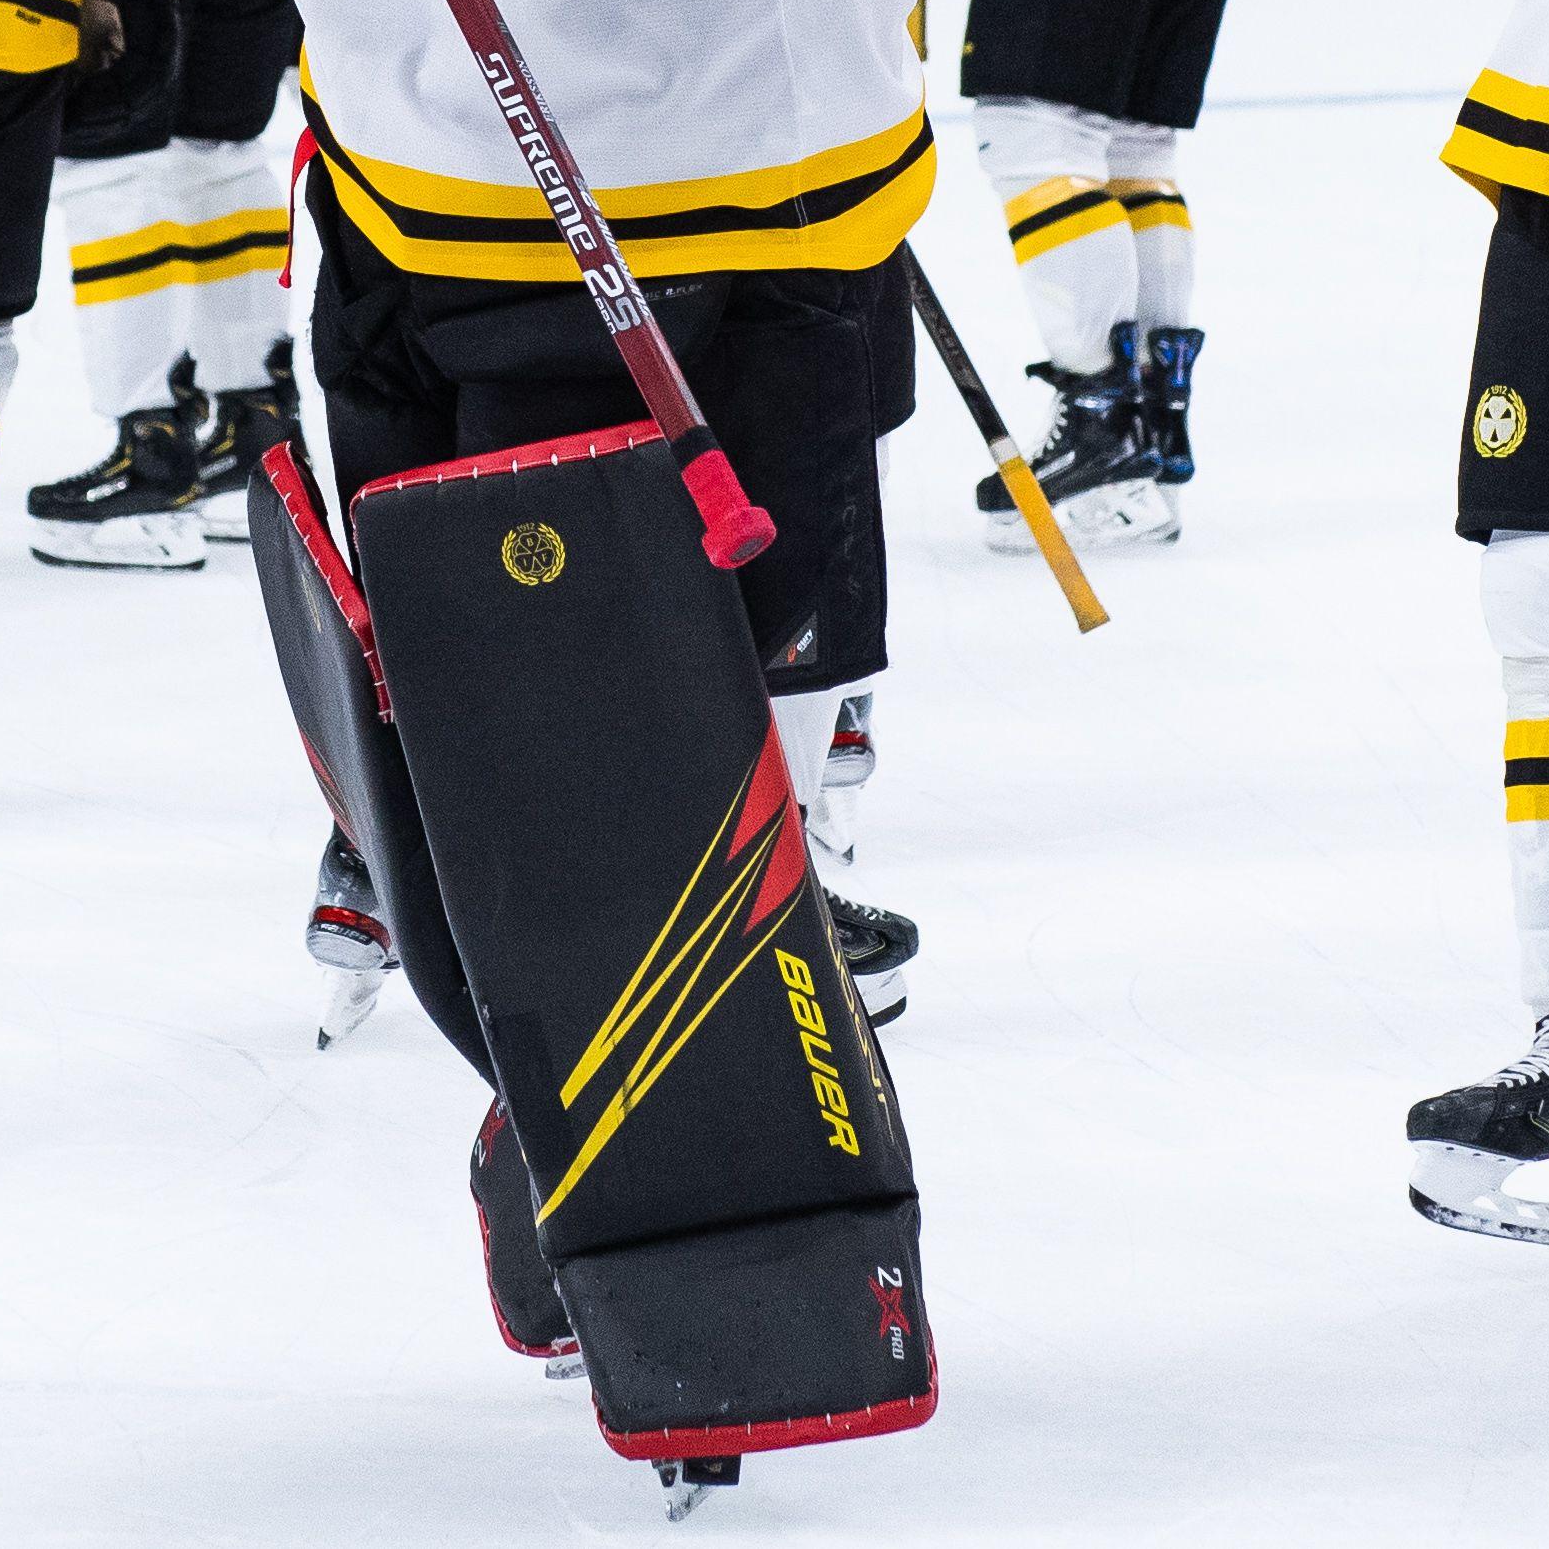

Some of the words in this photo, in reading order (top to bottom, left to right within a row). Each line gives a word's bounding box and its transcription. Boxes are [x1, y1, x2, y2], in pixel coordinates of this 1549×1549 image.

[475, 50, 598, 255] SUPREME
[774, 947, 861, 1157] BAUER
[889, 1325, 905, 1361] PRO
